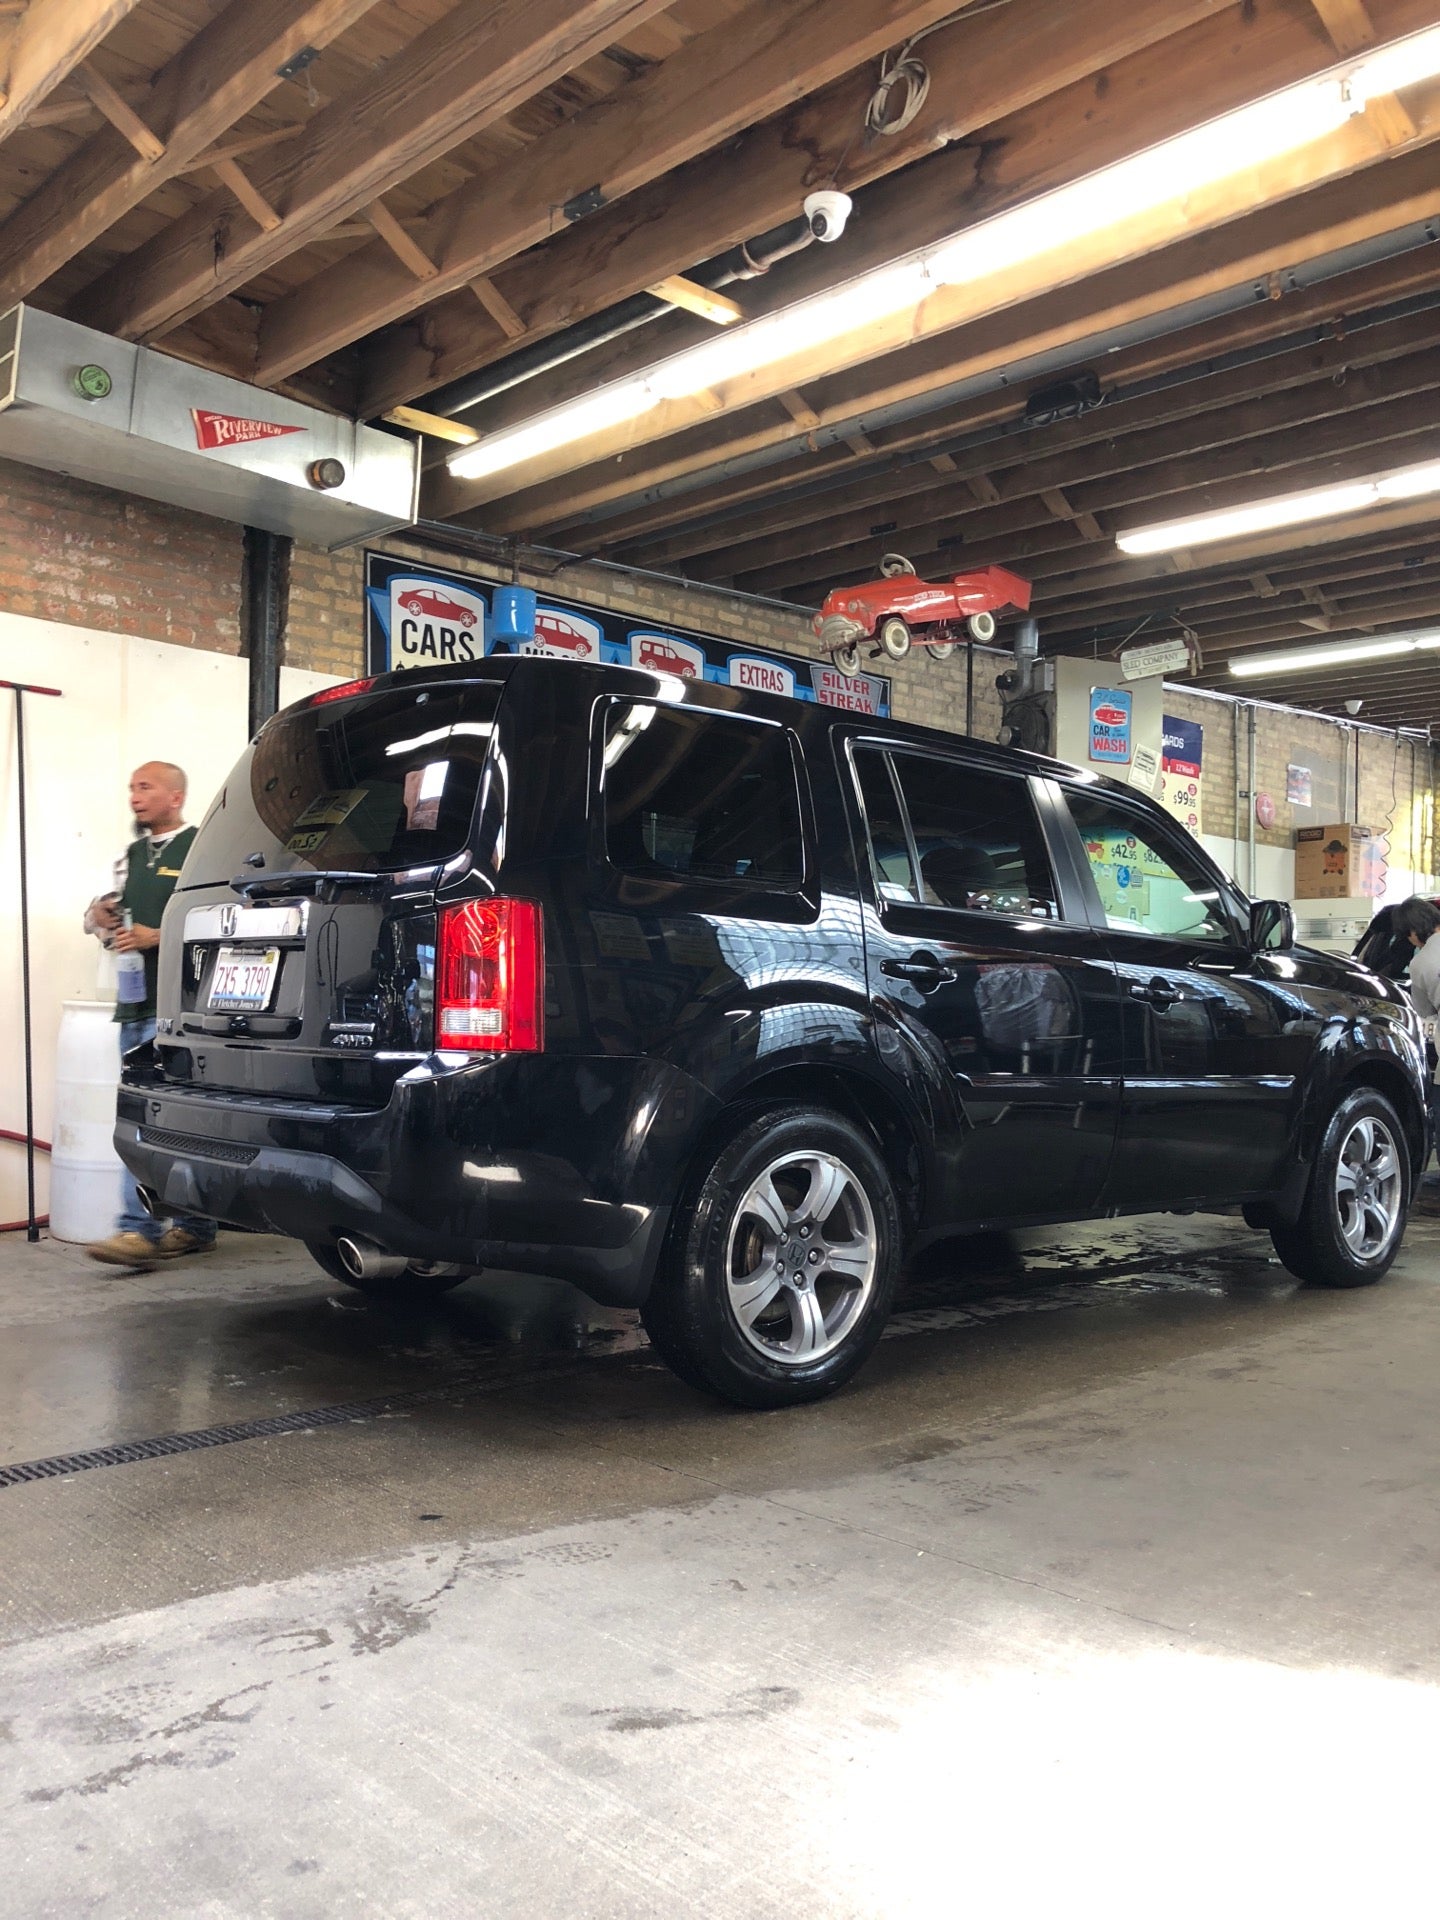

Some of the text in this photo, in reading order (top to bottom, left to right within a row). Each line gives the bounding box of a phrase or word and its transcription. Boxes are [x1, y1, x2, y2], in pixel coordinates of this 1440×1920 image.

[235, 432, 261, 442] PARK
[401, 618, 475, 662] CARS
[1142, 652, 1178, 666] COMPANY
[740, 662, 784, 692] EXTRAS
[821, 671, 870, 696] SILVER
[819, 689, 873, 714] STREAK
[1093, 725, 1110, 736] CAR
[1093, 737, 1127, 753] WASH
[1173, 790, 1196, 808] $99.95
[1111, 843, 1137, 860] $42.95
[214, 966, 270, 997] ZX5 3790
